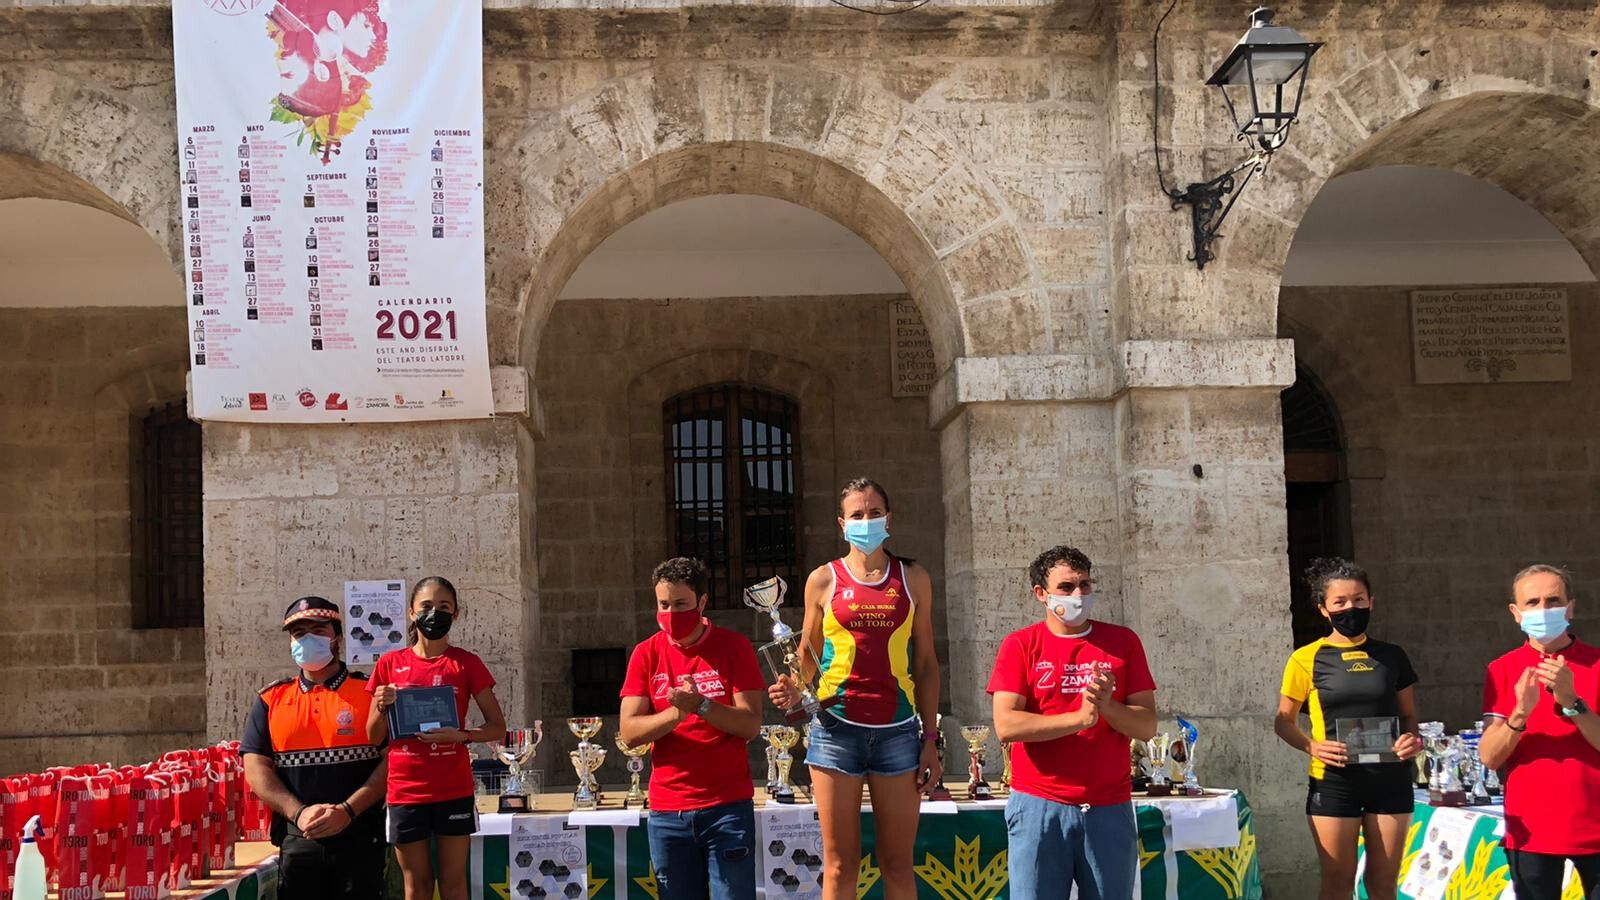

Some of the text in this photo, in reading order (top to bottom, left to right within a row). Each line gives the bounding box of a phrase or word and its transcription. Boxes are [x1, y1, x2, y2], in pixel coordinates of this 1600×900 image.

[378, 297, 452, 306] CALENDARIO
[376, 310, 458, 340] 2021
[64, 836, 88, 848] TORO
[130, 834, 154, 846] TORO
[60, 886, 90, 900] TORO
[127, 886, 156, 900] TORO
